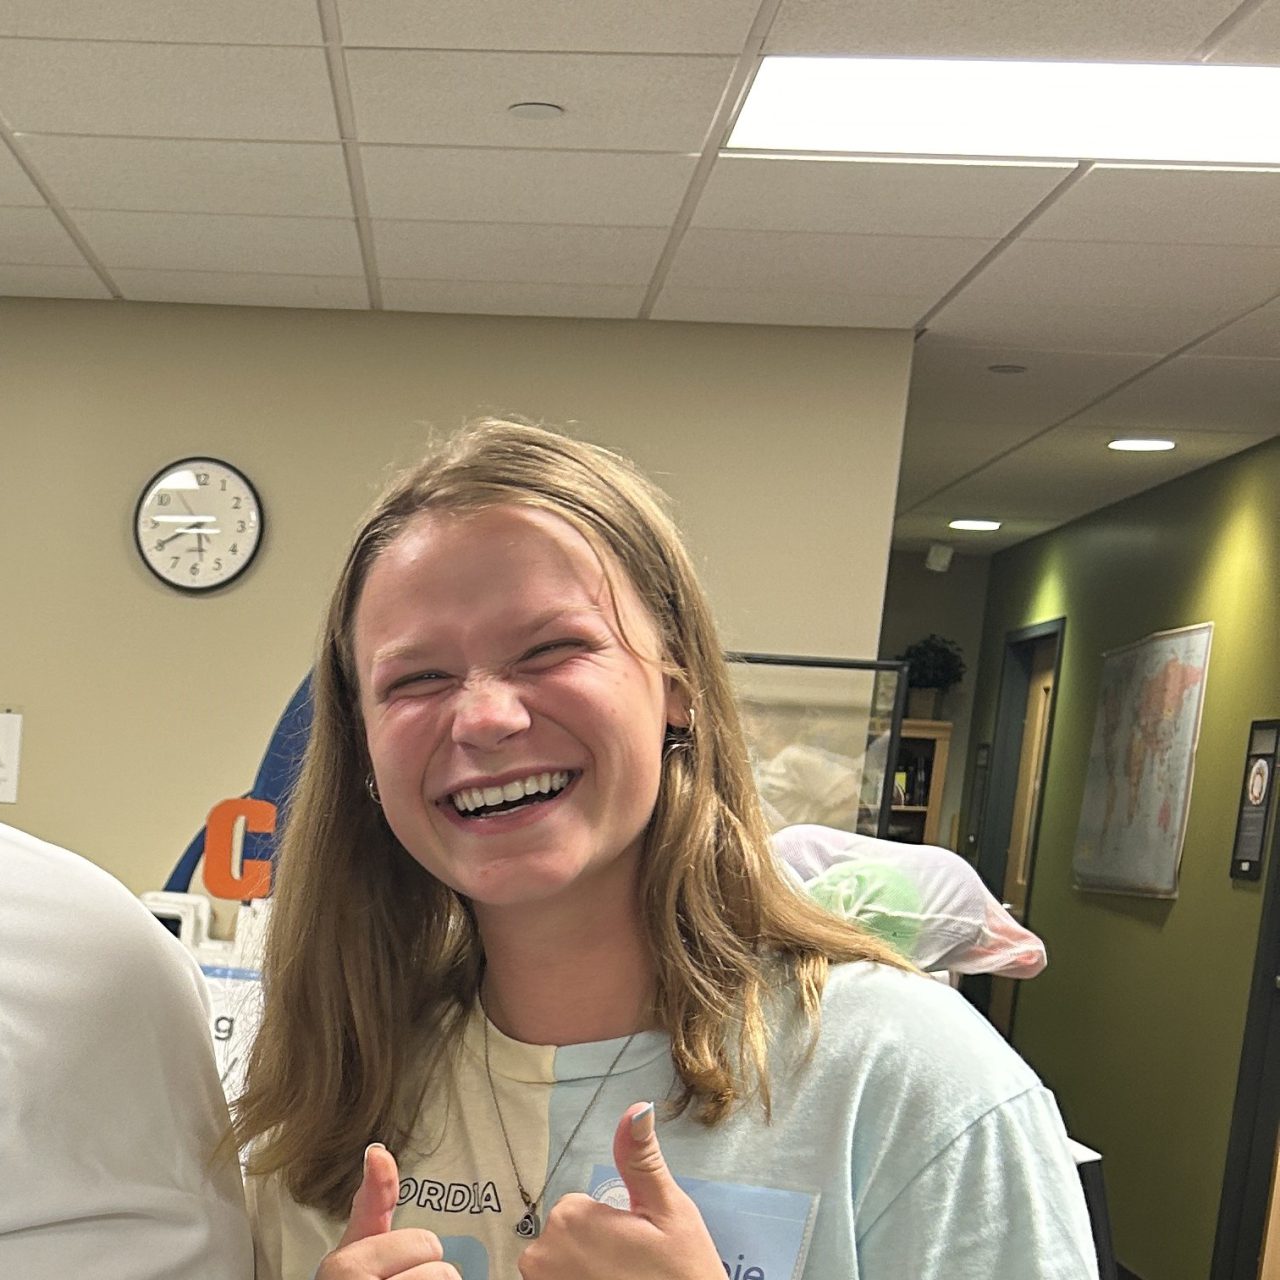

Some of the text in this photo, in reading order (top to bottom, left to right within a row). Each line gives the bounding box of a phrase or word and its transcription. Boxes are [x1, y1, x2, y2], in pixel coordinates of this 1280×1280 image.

[196, 473, 210, 486] 12
[220, 479, 227, 491] 1
[158, 493, 172, 506] 10
[231, 496, 242, 509] 2
[236, 520, 247, 533] 3
[228, 543, 238, 555] 4
[169, 556, 180, 569] 7
[189, 562, 200, 576] 6
[212, 558, 223, 571] 5
[203, 797, 277, 900] C
[395, 1177, 501, 1214] ORDIA
